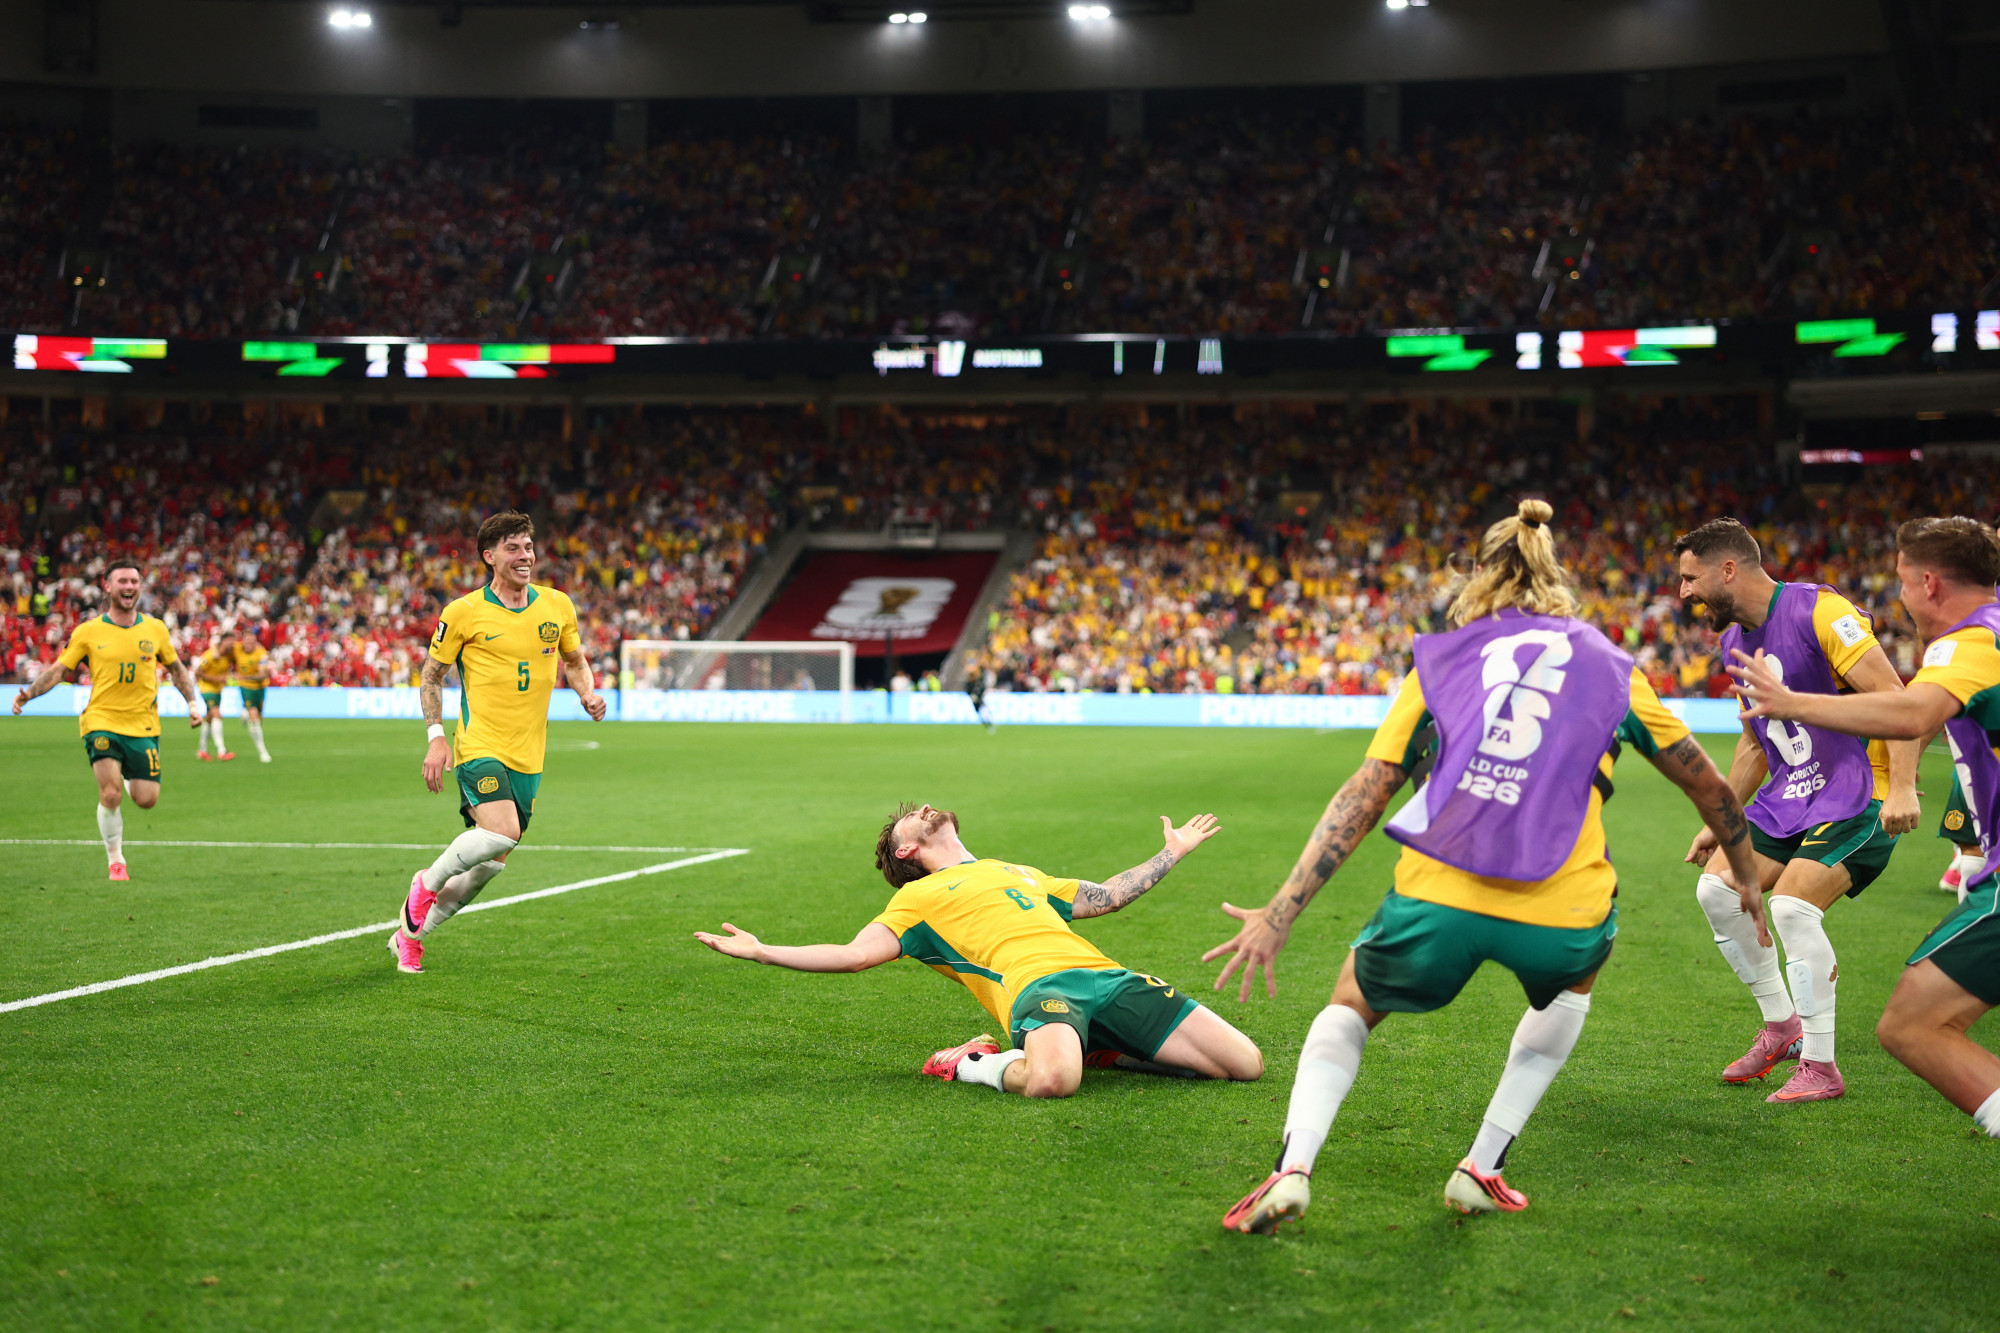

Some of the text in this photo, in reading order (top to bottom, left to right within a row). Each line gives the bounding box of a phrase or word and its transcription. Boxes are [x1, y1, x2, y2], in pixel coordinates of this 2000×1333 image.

[118, 662, 136, 684] 13
[517, 661, 530, 692] 5
[1200, 696, 1380, 725] POWERADE
[1487, 726, 1510, 743] FA
[145, 748, 160, 770] 13
[1493, 764, 1528, 781] CUP
[1456, 770, 1521, 805] 026
[1782, 774, 1827, 799] 2026
[1004, 887, 1035, 911] 8
